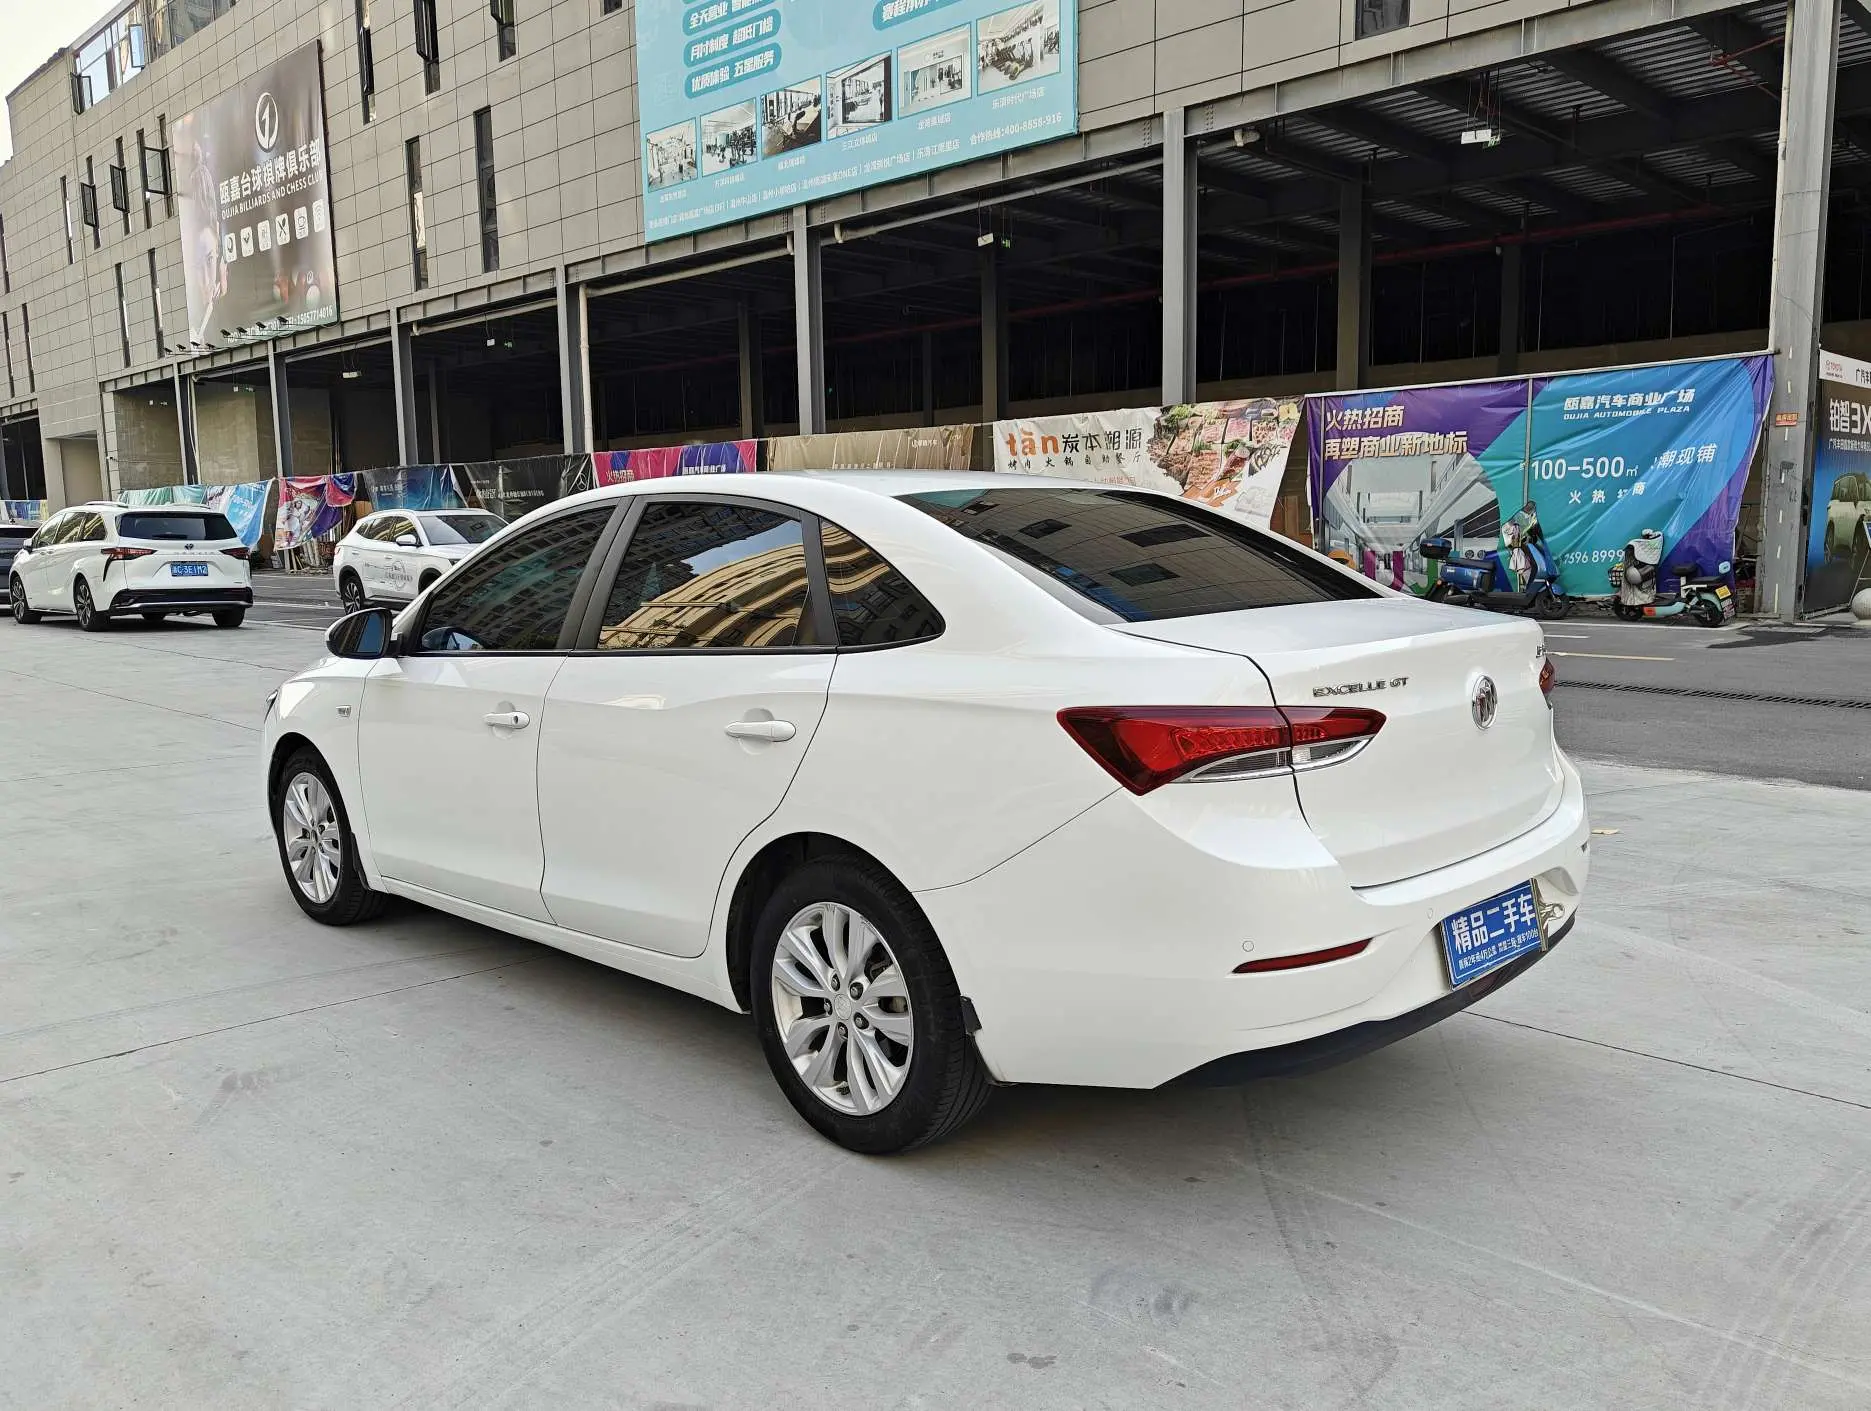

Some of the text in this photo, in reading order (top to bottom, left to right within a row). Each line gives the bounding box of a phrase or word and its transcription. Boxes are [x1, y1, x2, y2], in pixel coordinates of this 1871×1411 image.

[733, 49, 775, 77] 五星服务
[219, 137, 321, 205] 瓯嘉台球棋牌俱乐部
[221, 205, 240, 220] OUJIA
[240, 192, 271, 213] BILLIARDS
[271, 186, 286, 200] AND
[286, 176, 307, 195] CHESS
[1563, 388, 1696, 411] 瓯嘉汽车商业广场
[1563, 412, 1589, 420] OUJIA
[1656, 405, 1690, 414] PLAZA
[1325, 405, 1405, 431] 火热招商
[1324, 431, 1468, 461] 再塑商业新地标
[1651, 443, 1717, 470] 潮现铺
[1312, 677, 1409, 698] EXCELLE GT
[1451, 893, 1536, 955] 精品二手车
